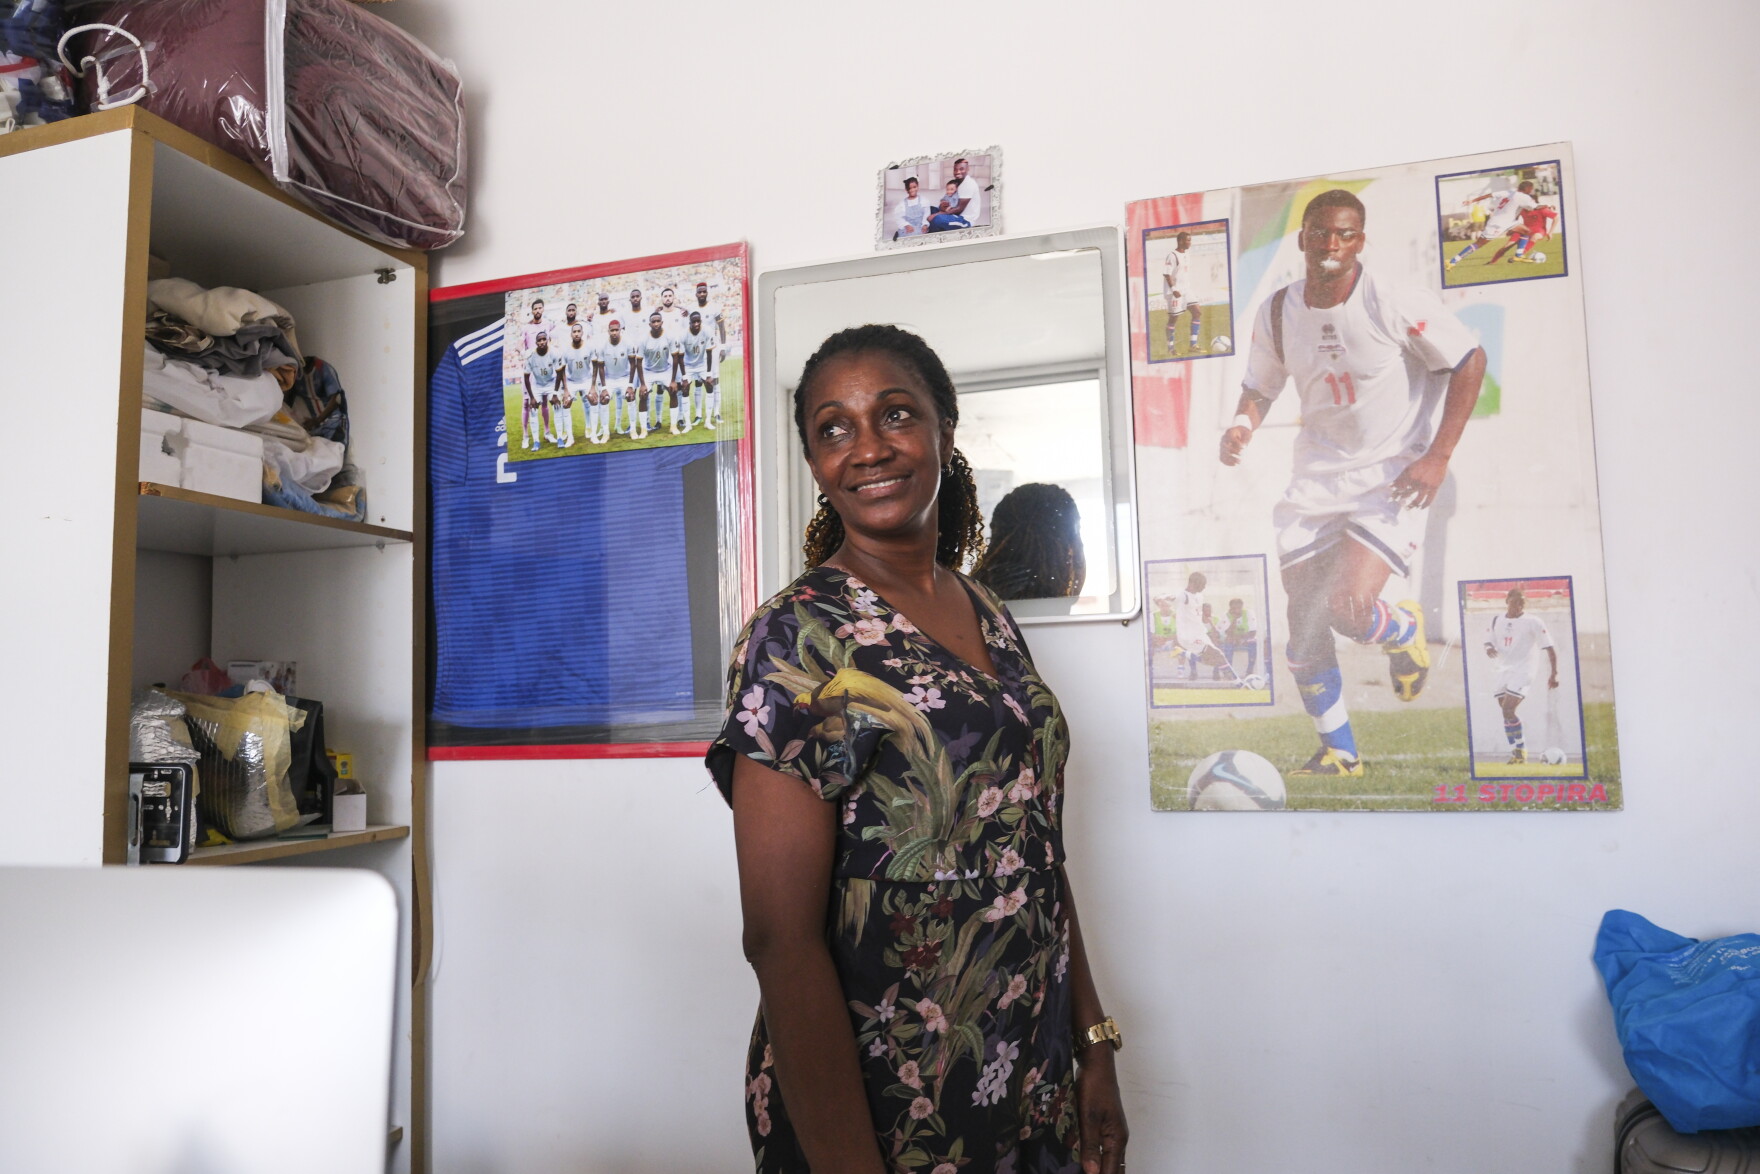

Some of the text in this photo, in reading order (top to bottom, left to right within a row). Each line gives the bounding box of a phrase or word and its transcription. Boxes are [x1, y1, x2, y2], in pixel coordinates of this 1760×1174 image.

[575, 360, 583, 370] 18
[613, 357, 618, 366] 7
[540, 367, 548, 376] 16
[1324, 371, 1357, 405] 11
[1432, 783, 1608, 803] 11 STOPIRA
